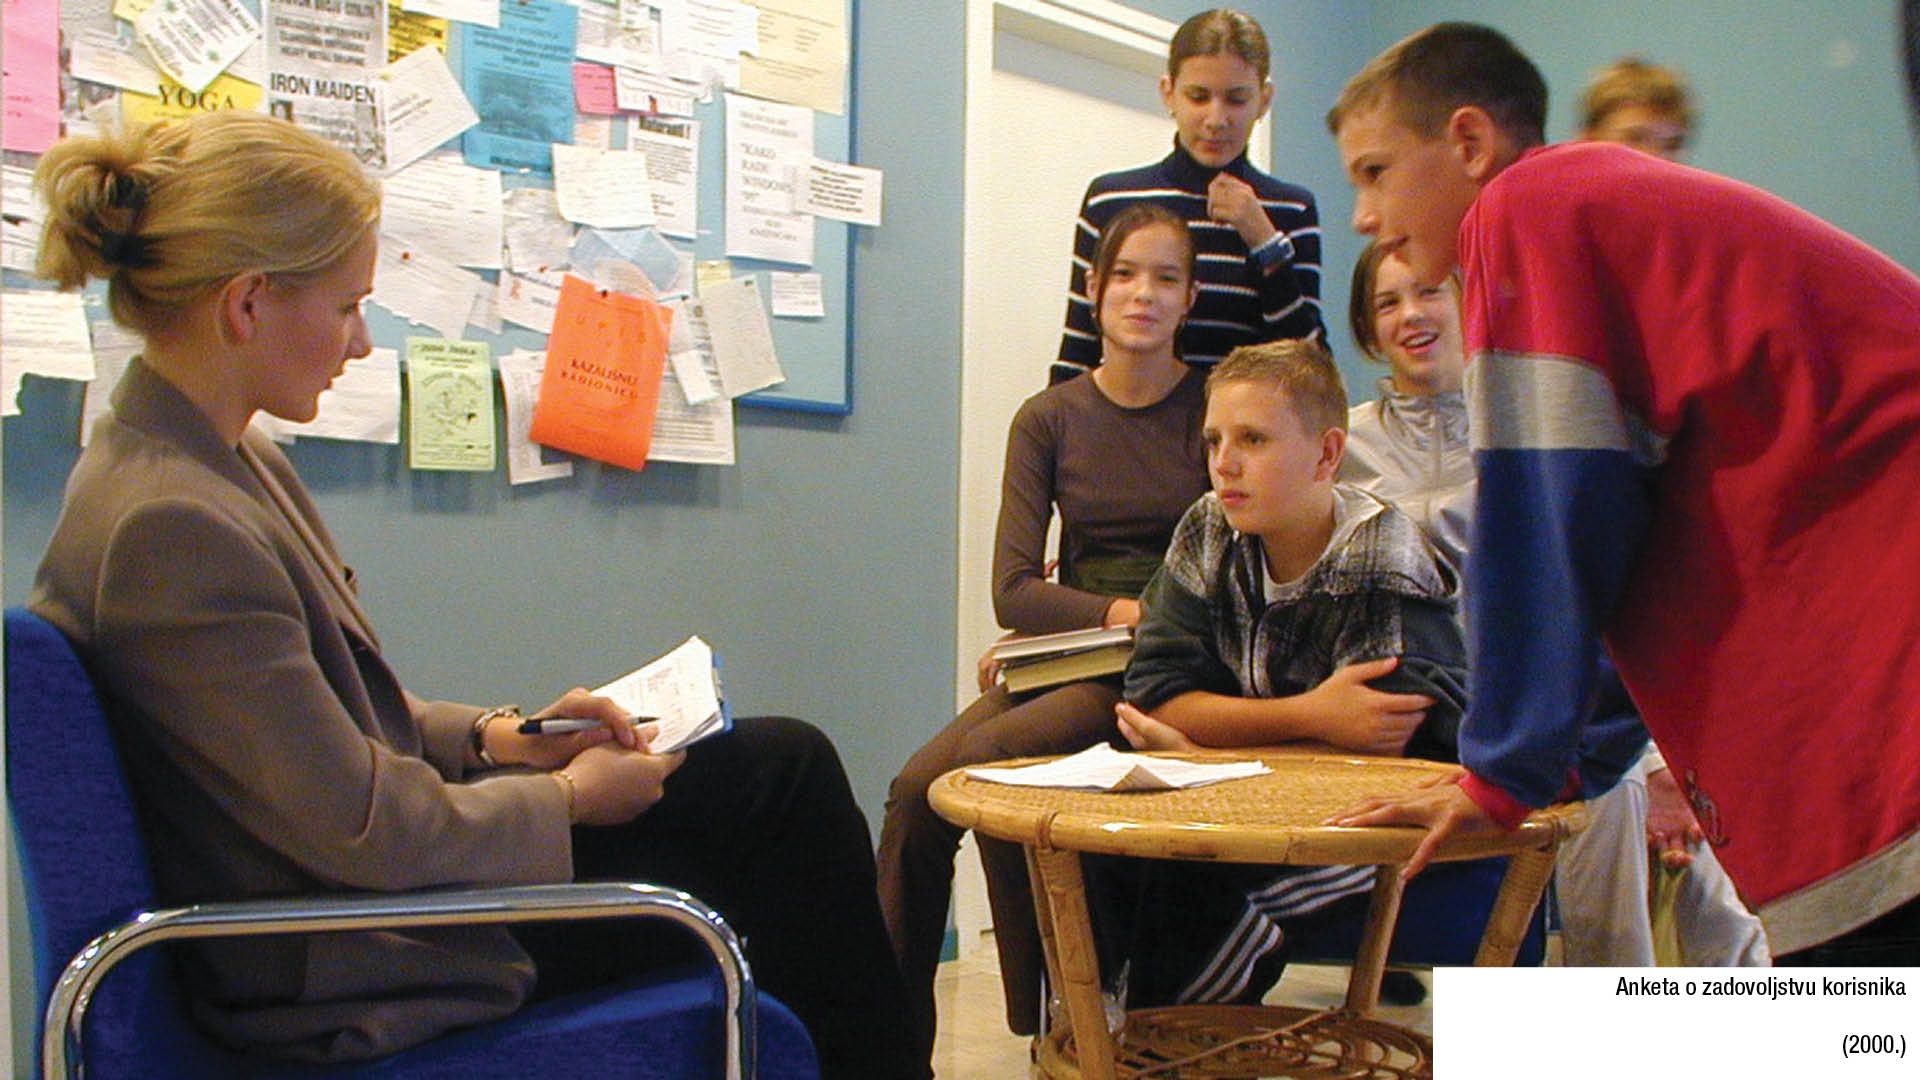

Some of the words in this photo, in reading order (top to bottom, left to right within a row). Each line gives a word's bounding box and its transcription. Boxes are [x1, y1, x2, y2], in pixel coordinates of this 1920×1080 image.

[159, 84, 235, 112] YOGA
[270, 72, 310, 95] IRON
[315, 79, 376, 104] MAIDEN
